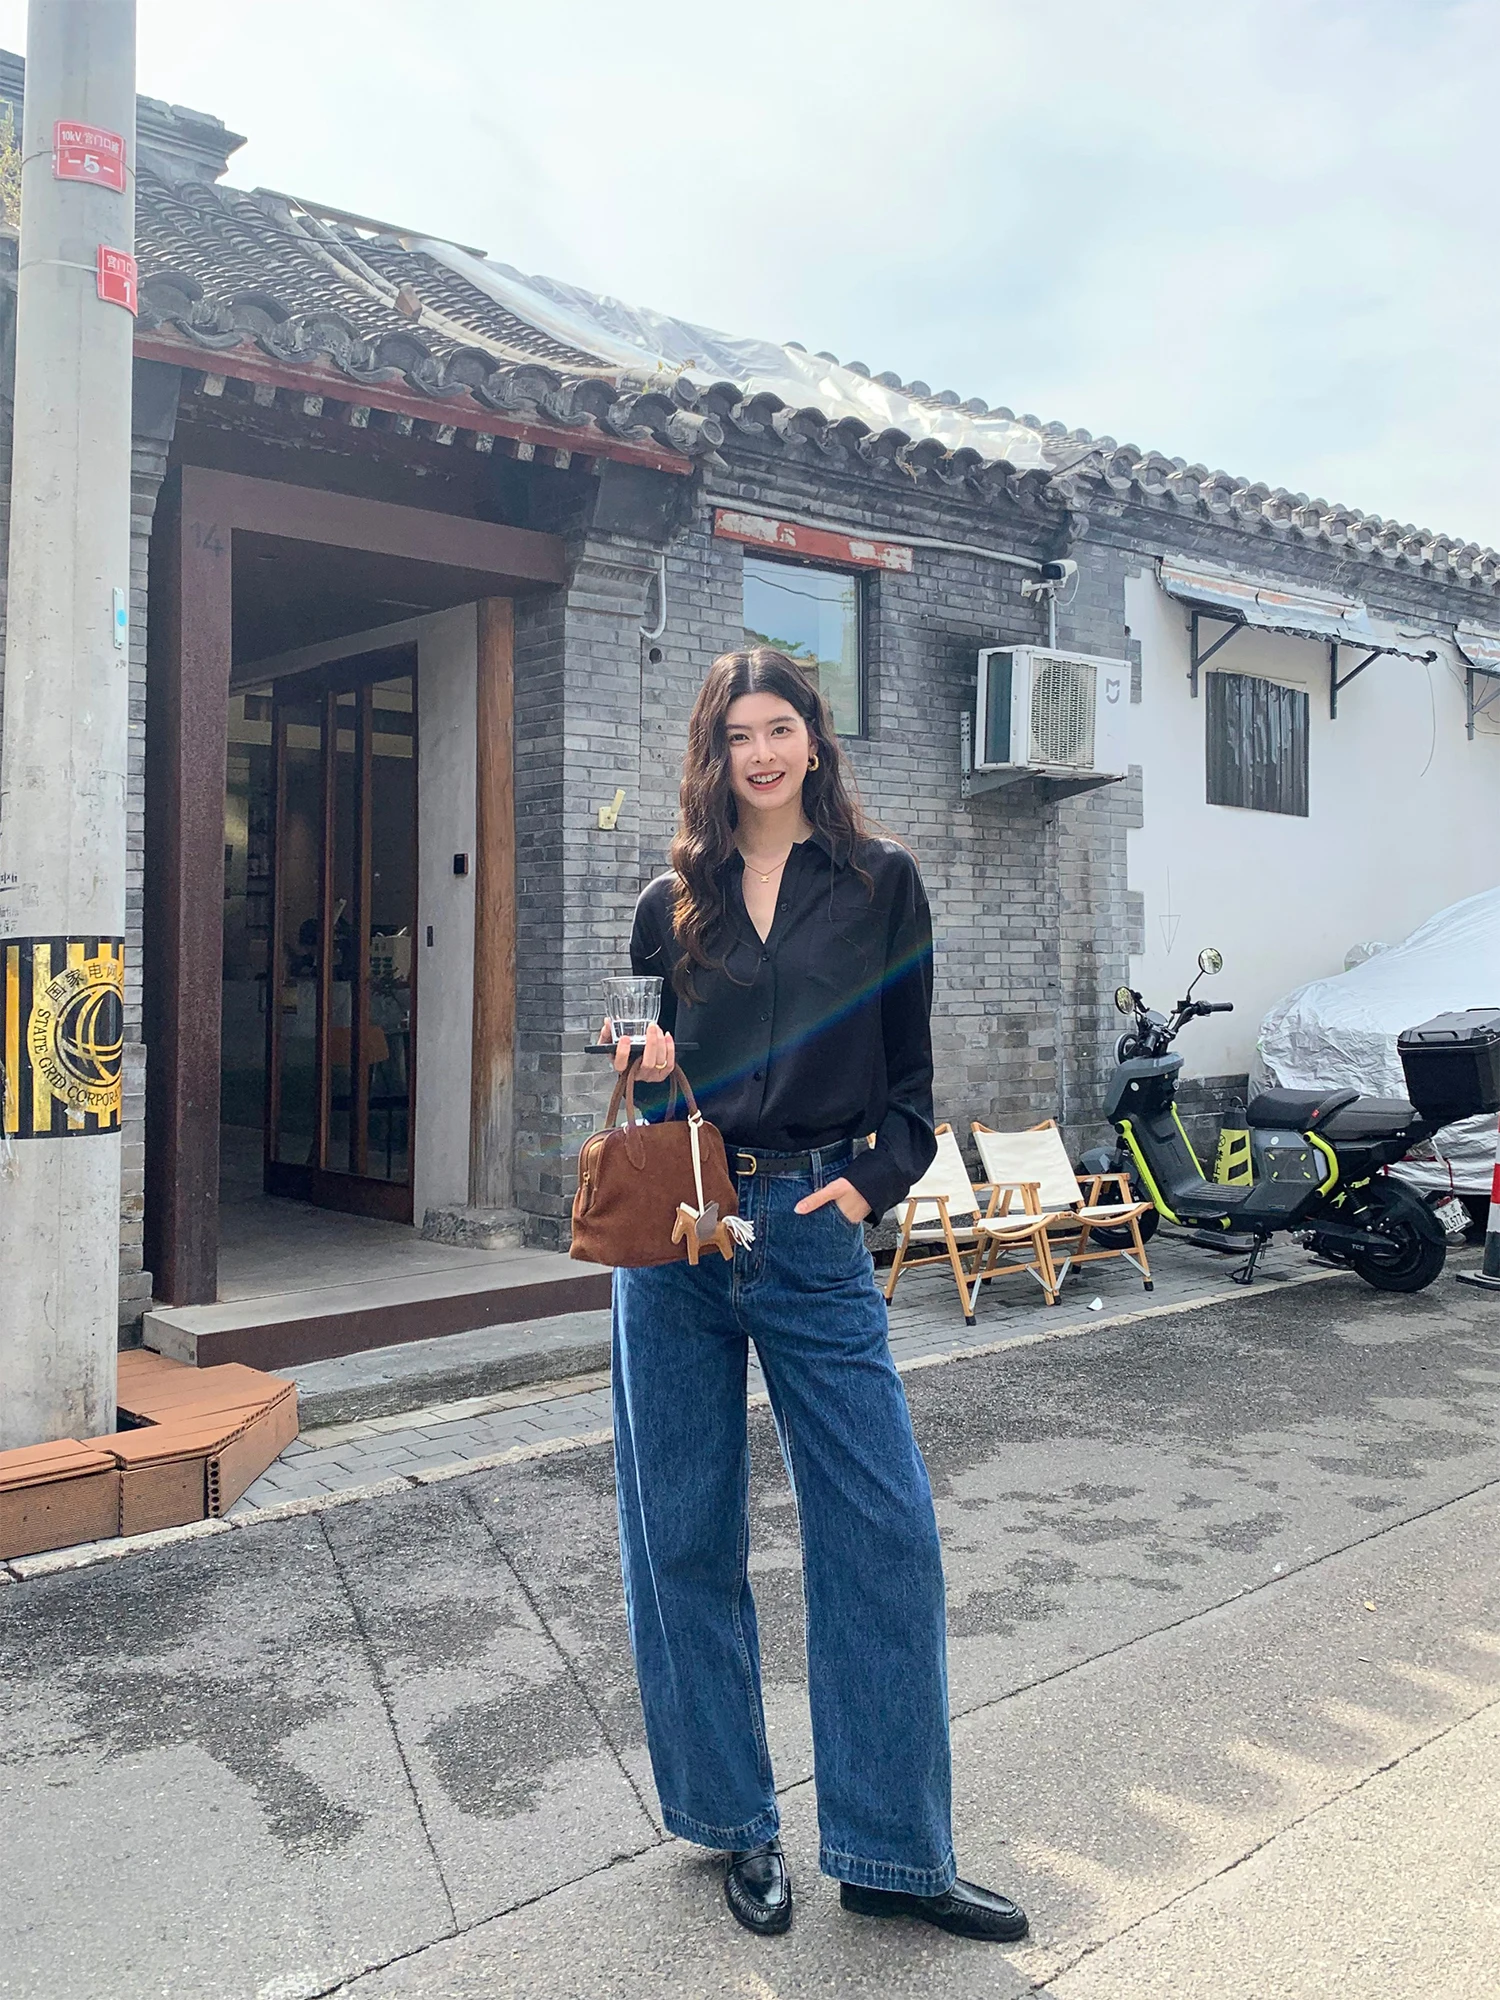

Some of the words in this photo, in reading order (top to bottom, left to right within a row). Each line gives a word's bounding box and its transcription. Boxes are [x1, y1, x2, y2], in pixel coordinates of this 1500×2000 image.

[61, 131, 81, 142] 10kV
[189, 520, 224, 558] 14
[33, 1008, 51, 1054] STATE
[38, 1057, 67, 1090] GRID
